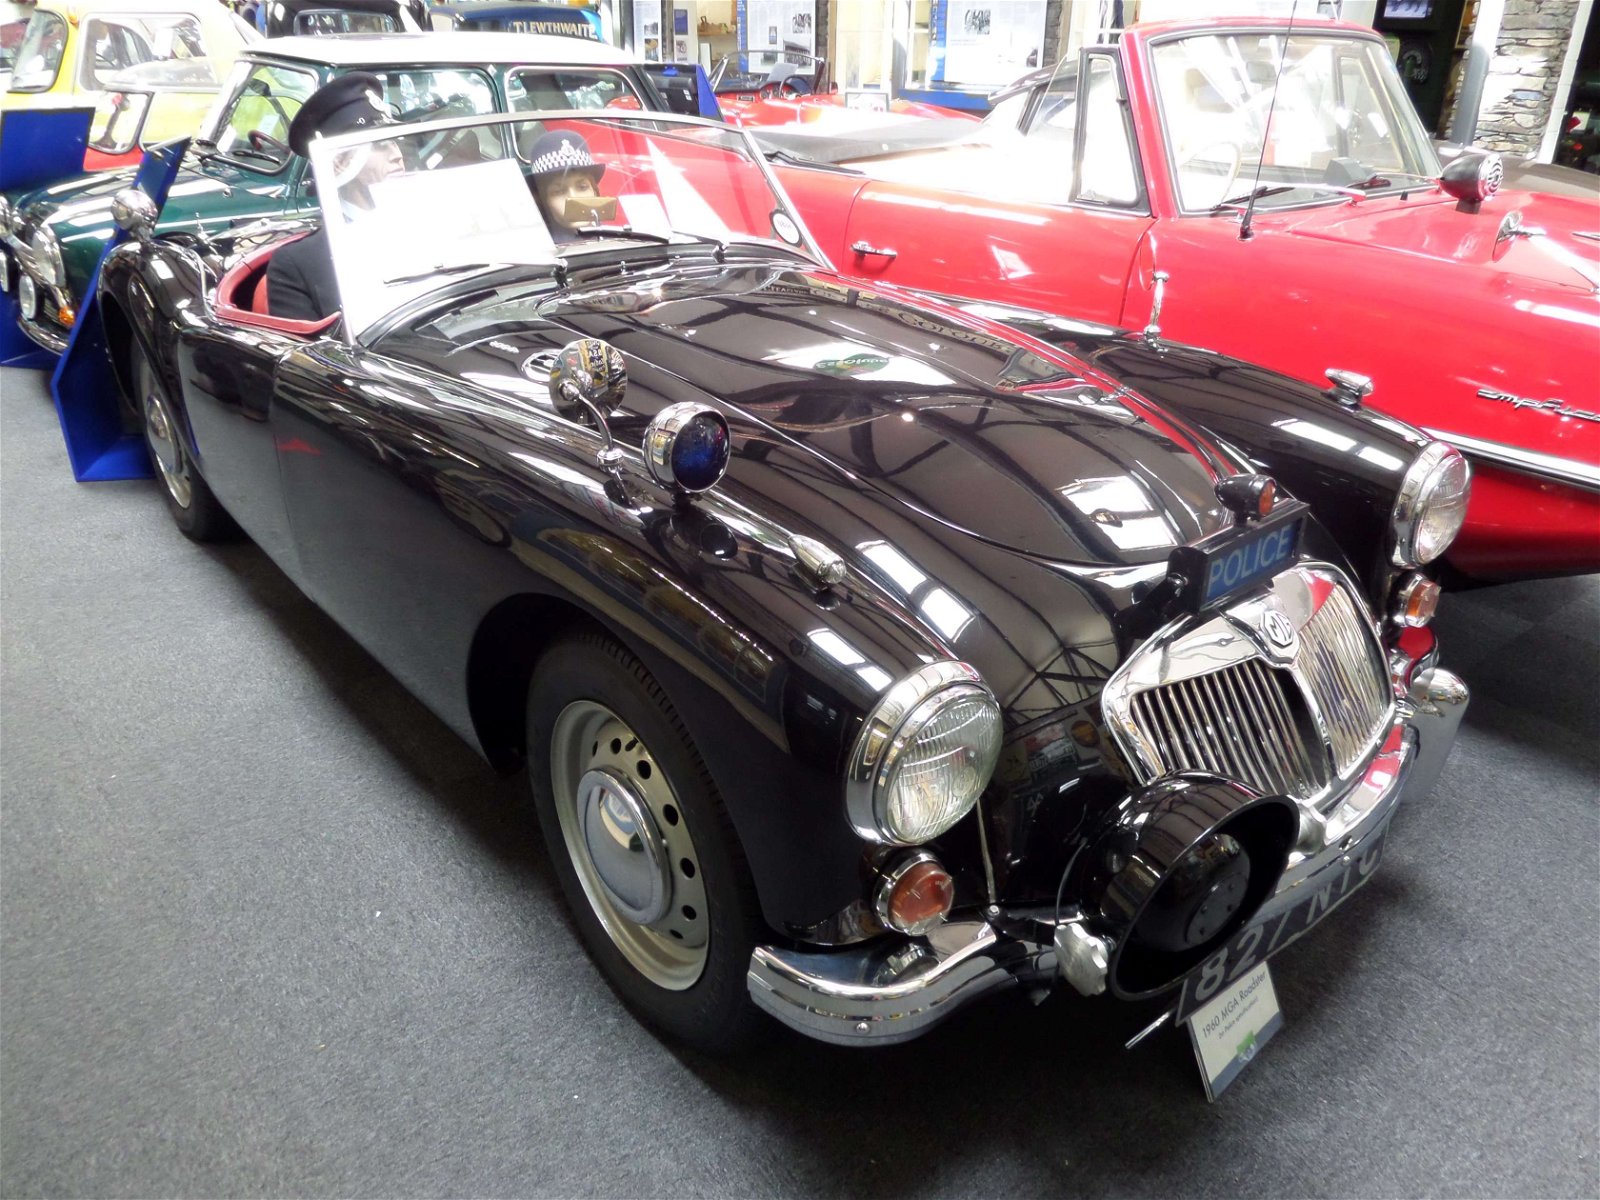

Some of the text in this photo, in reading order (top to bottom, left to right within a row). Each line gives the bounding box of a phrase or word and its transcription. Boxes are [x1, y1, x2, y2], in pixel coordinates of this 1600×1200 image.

[1206, 524, 1291, 597] POLICE
[1269, 612, 1293, 642] MG
[1202, 971, 1266, 1038] 1960 MGA Roadster
